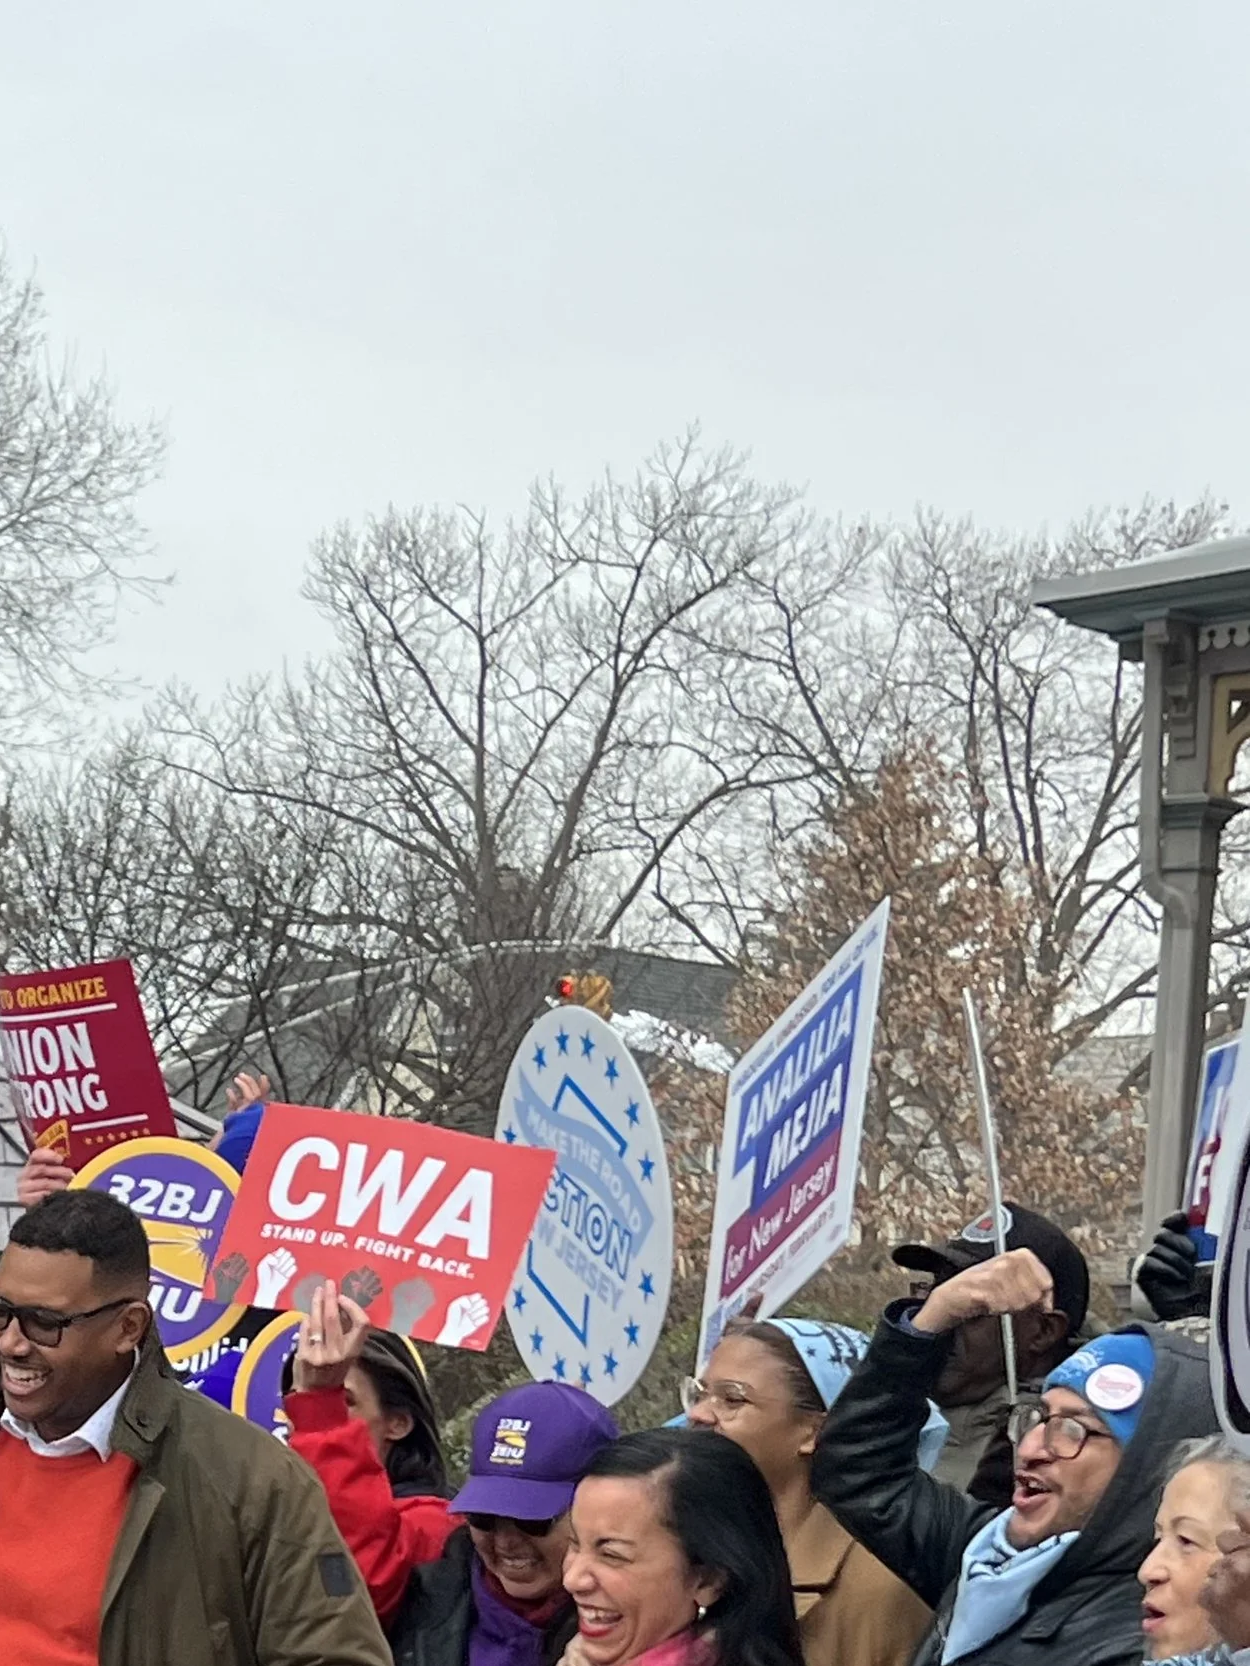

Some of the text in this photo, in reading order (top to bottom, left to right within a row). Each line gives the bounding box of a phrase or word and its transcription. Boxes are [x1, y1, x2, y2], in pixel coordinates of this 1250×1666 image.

[16, 976, 109, 1009] ORGANIZE
[1, 1022, 96, 1076] NION
[739, 988, 854, 1151] ANALILIA
[17, 1073, 109, 1120] RONG
[763, 1063, 843, 1190] MEJIA
[268, 1137, 494, 1260] CWA
[569, 1134, 600, 1174] THE
[600, 1165, 643, 1234] ROAD
[725, 1244, 748, 1285] for
[749, 1206, 785, 1261] New
[785, 1154, 836, 1223] Jersey
[261, 1223, 475, 1279] STAND UP. FIGHT BACK.
[554, 1231, 624, 1312] JERSEY
